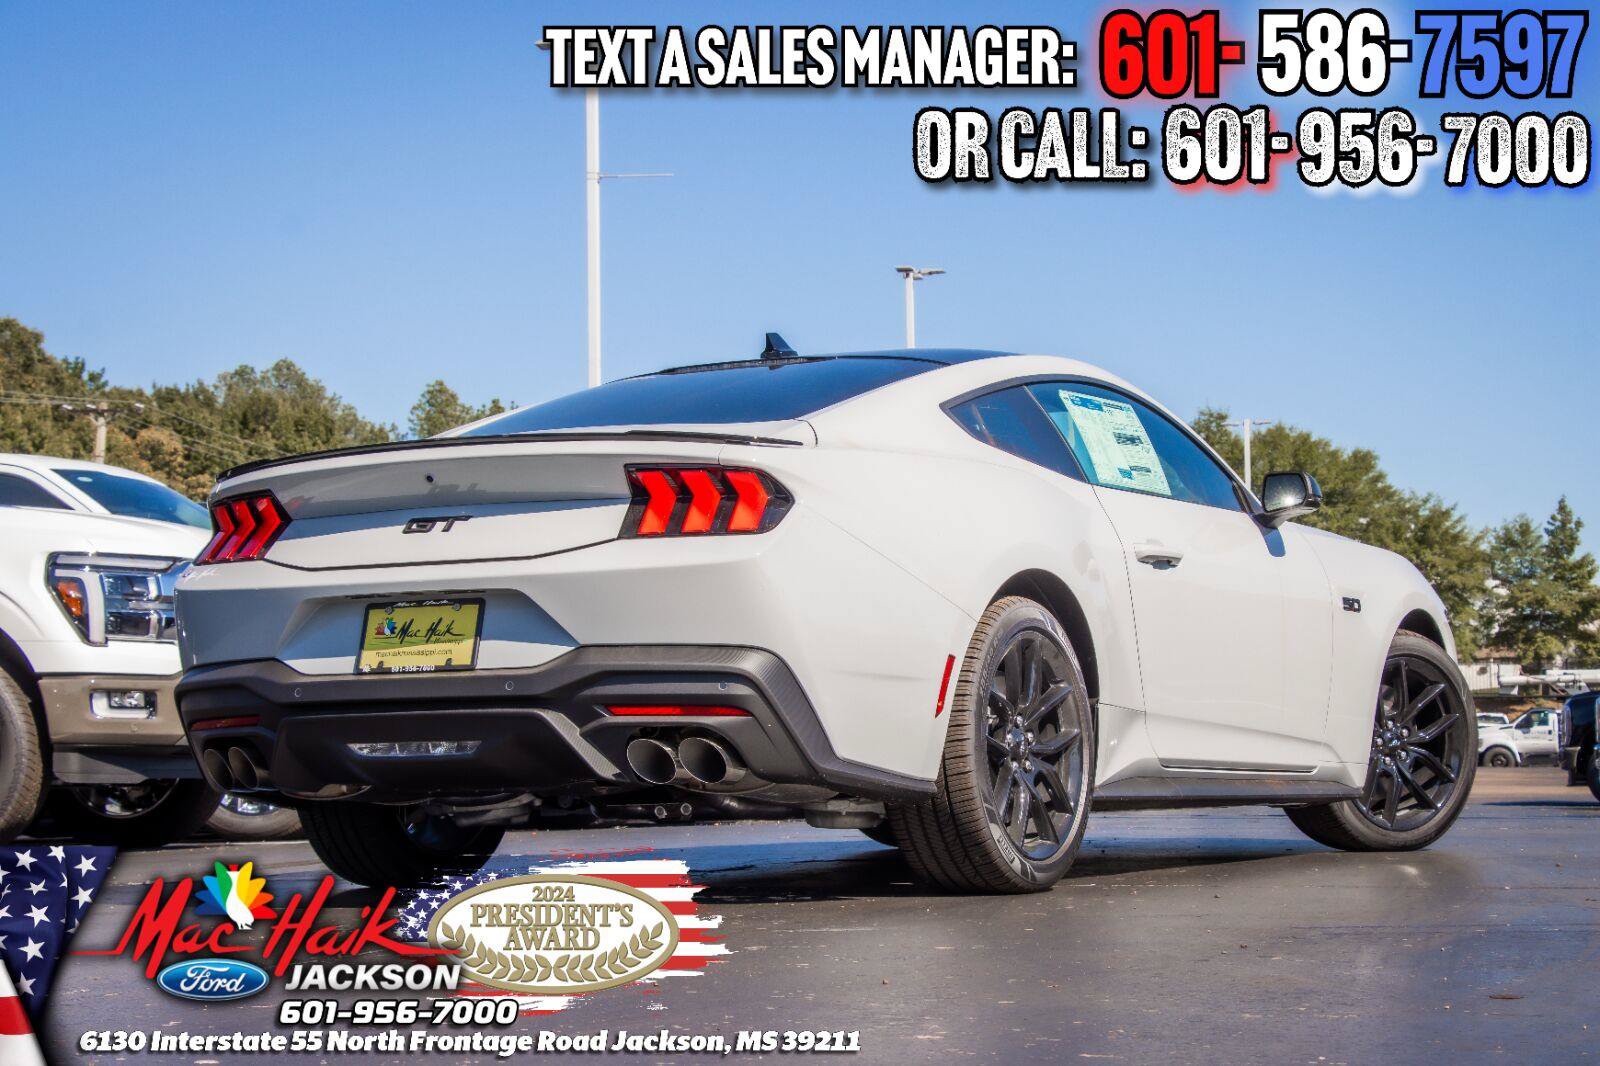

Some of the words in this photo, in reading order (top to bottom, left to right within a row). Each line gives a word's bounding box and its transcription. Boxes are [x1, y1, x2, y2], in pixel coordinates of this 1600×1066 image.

[402, 515, 473, 534] GT
[394, 617, 421, 644] Mac
[423, 616, 466, 644] Haik
